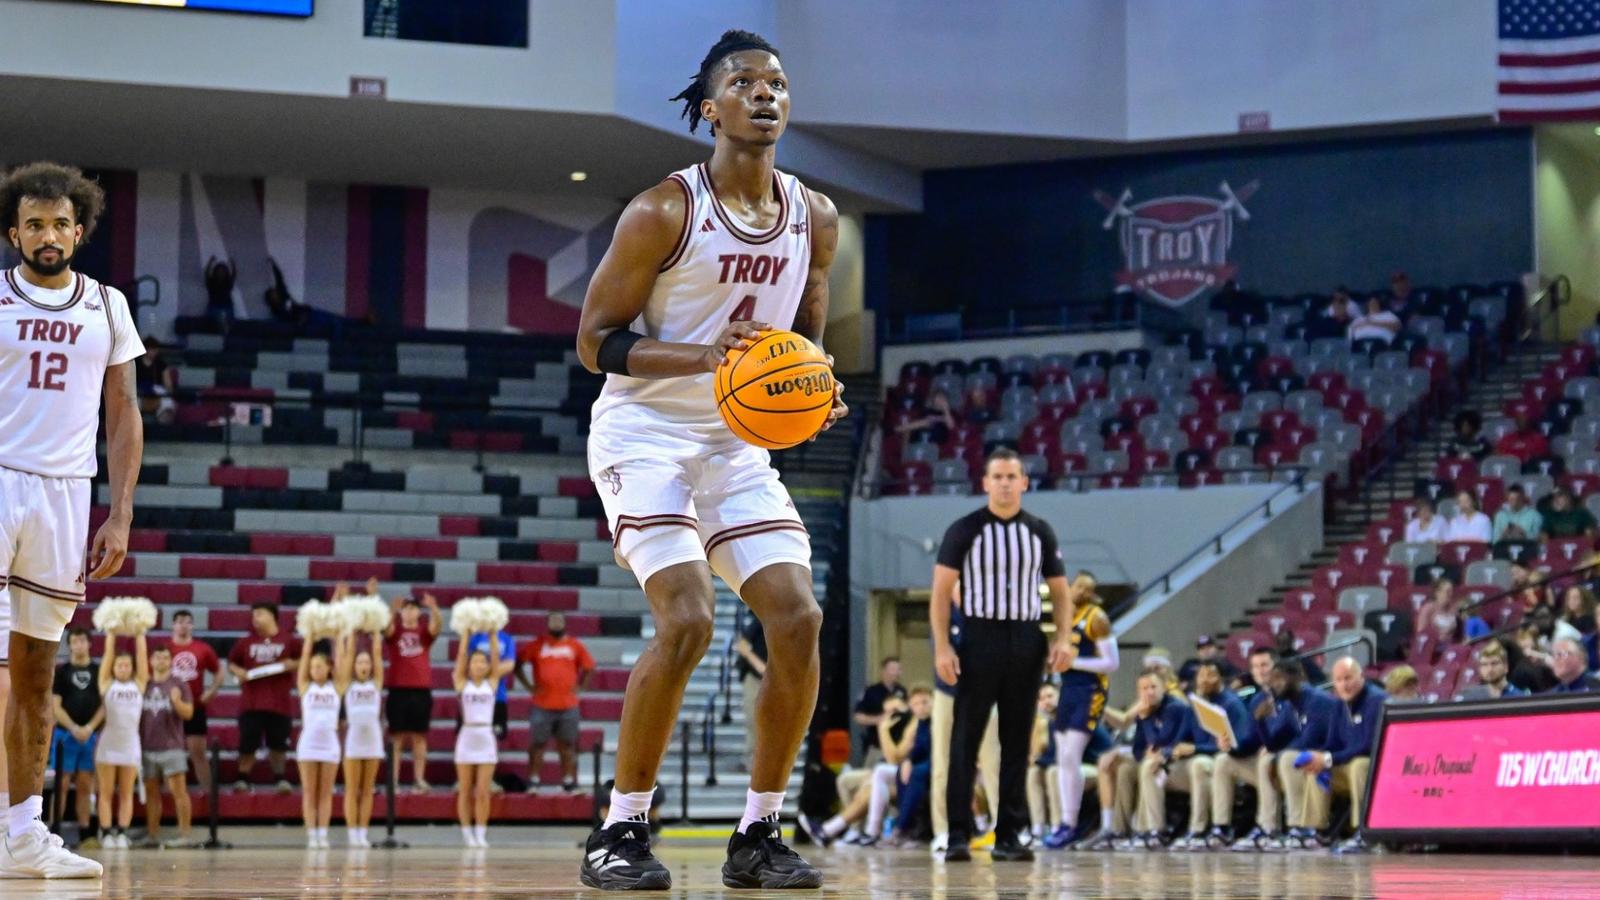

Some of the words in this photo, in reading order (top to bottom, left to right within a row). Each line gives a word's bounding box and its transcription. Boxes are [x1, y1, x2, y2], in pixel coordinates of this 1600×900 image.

[1137, 224, 1215, 269] TROY
[717, 253, 790, 286] TROY
[1136, 270, 1216, 288] TROJANS
[728, 295, 758, 323] 4
[16, 318, 84, 345] TROY
[27, 350, 69, 391] 12
[765, 372, 832, 396] Wilson
[1496, 752, 1524, 787] 115
[1522, 752, 1542, 786] W
